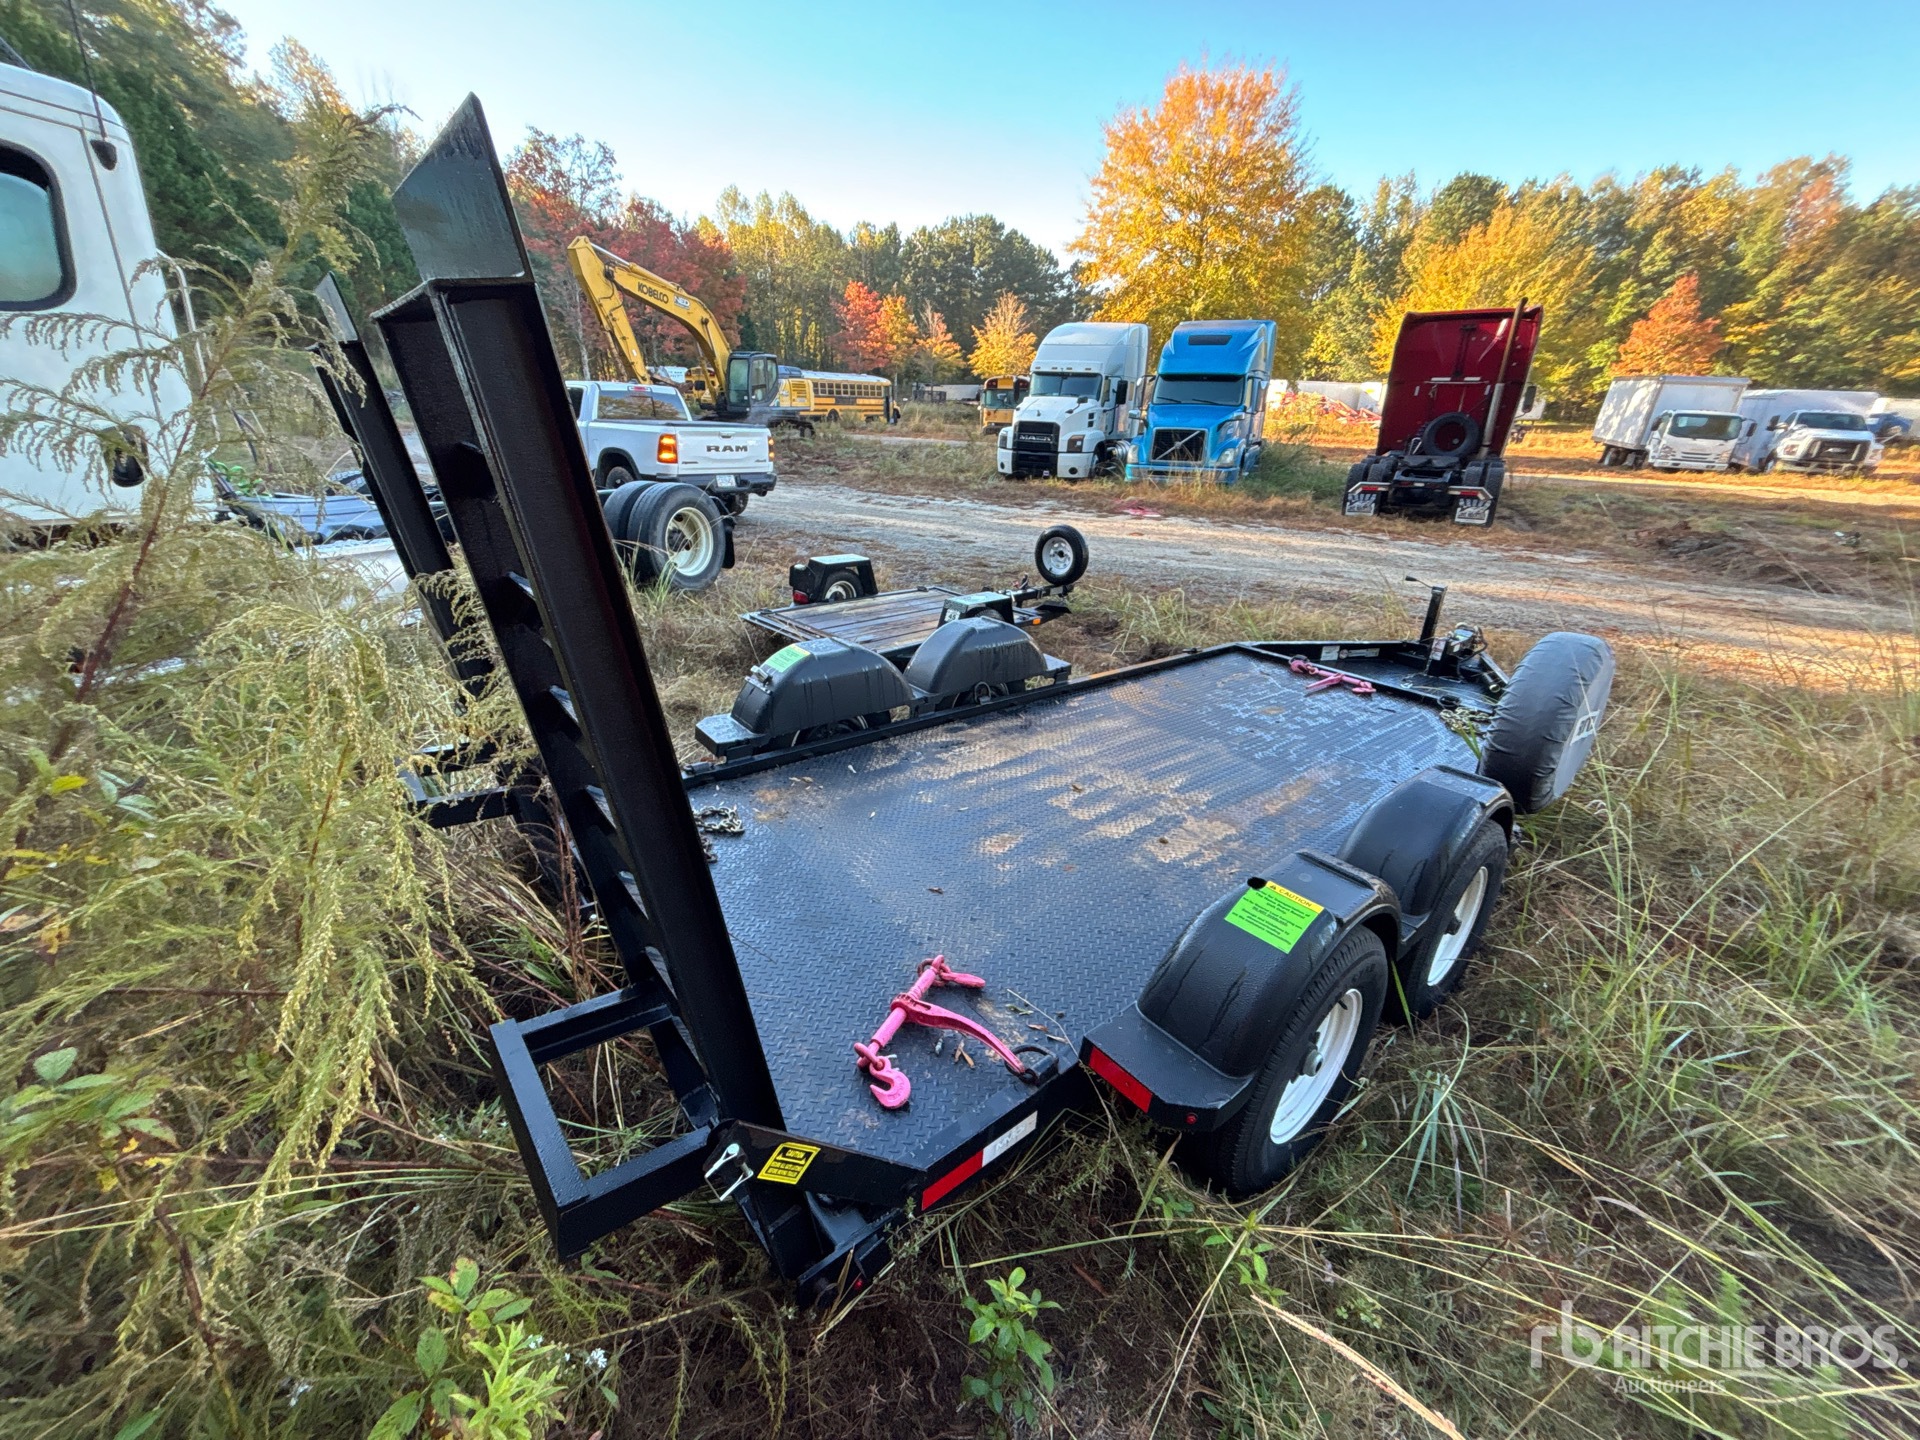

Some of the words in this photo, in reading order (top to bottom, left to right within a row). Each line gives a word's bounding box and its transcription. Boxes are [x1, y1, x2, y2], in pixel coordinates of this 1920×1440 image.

[637, 281, 669, 304] KOBELCO
[706, 445, 748, 453] RAM
[1279, 887, 1312, 907] CAUTION
